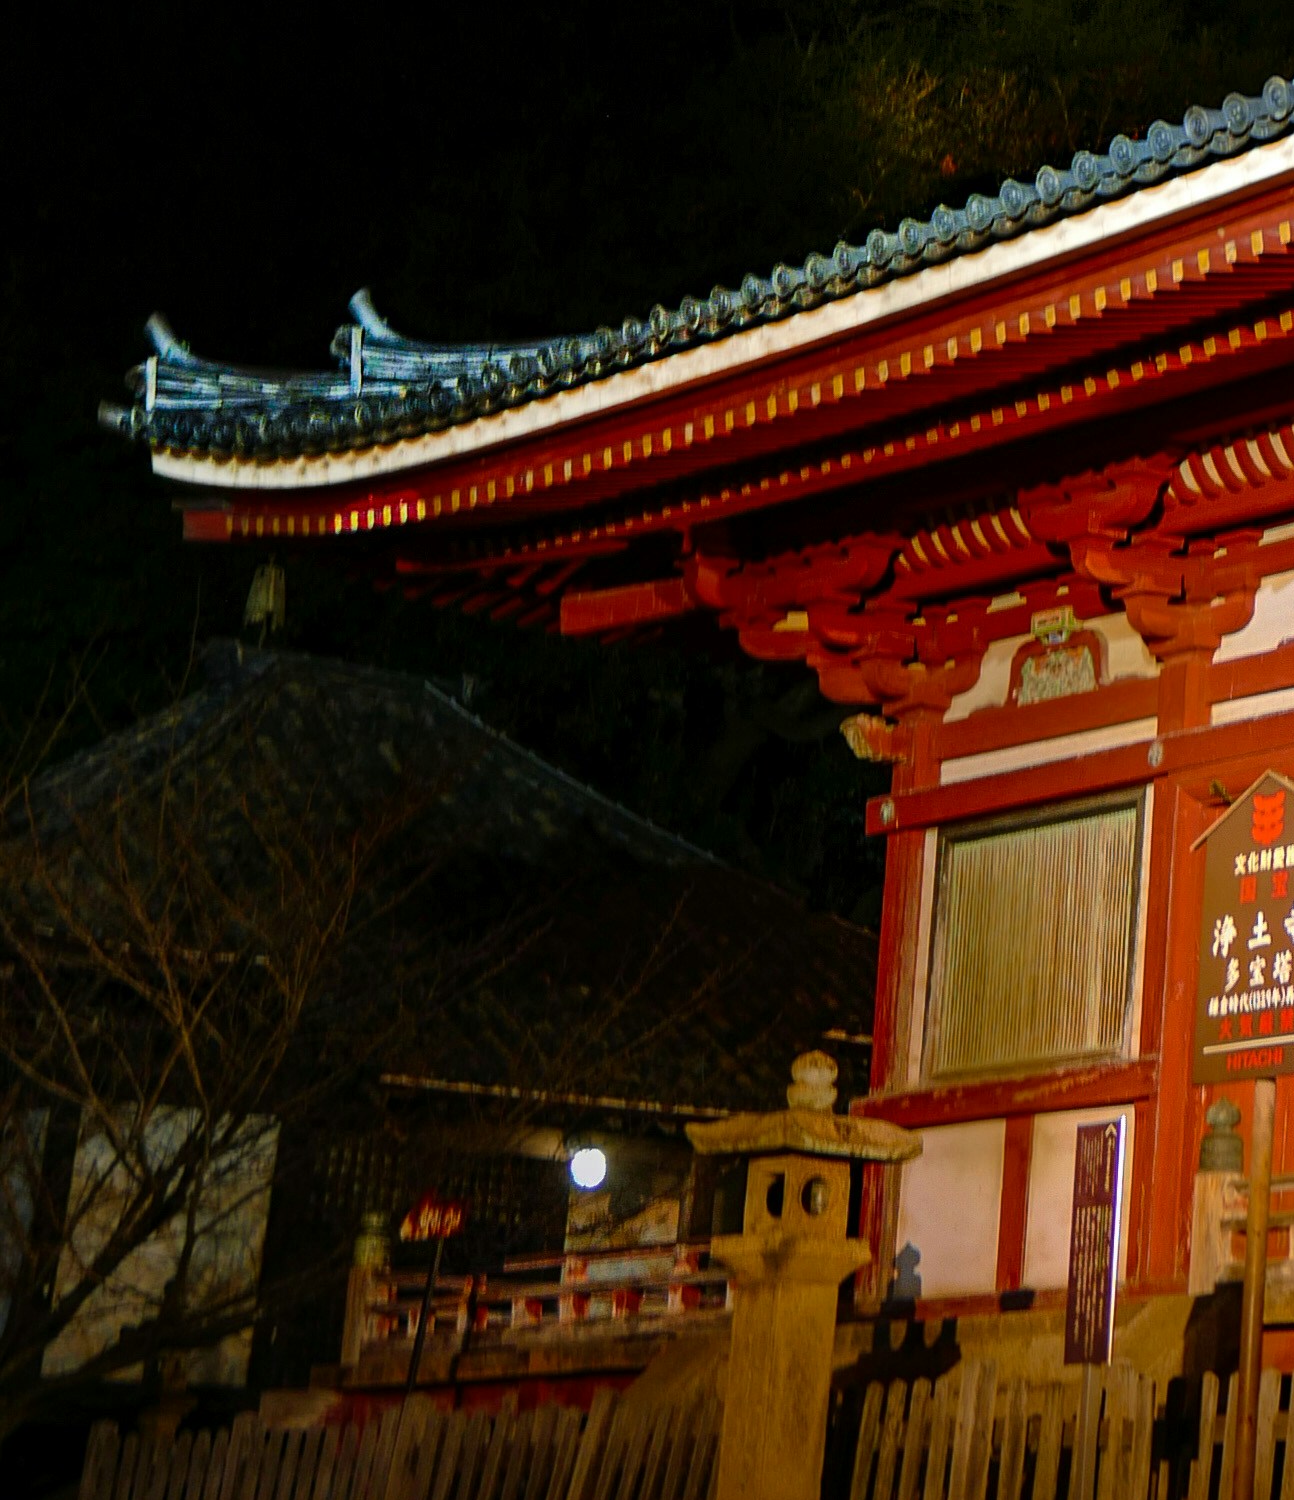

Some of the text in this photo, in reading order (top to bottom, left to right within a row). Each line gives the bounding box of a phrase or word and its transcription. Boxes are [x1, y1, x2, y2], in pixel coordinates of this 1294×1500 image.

[1224, 949, 1293, 993] 多宝塔
[1226, 1046, 1283, 1073] HITACHI
